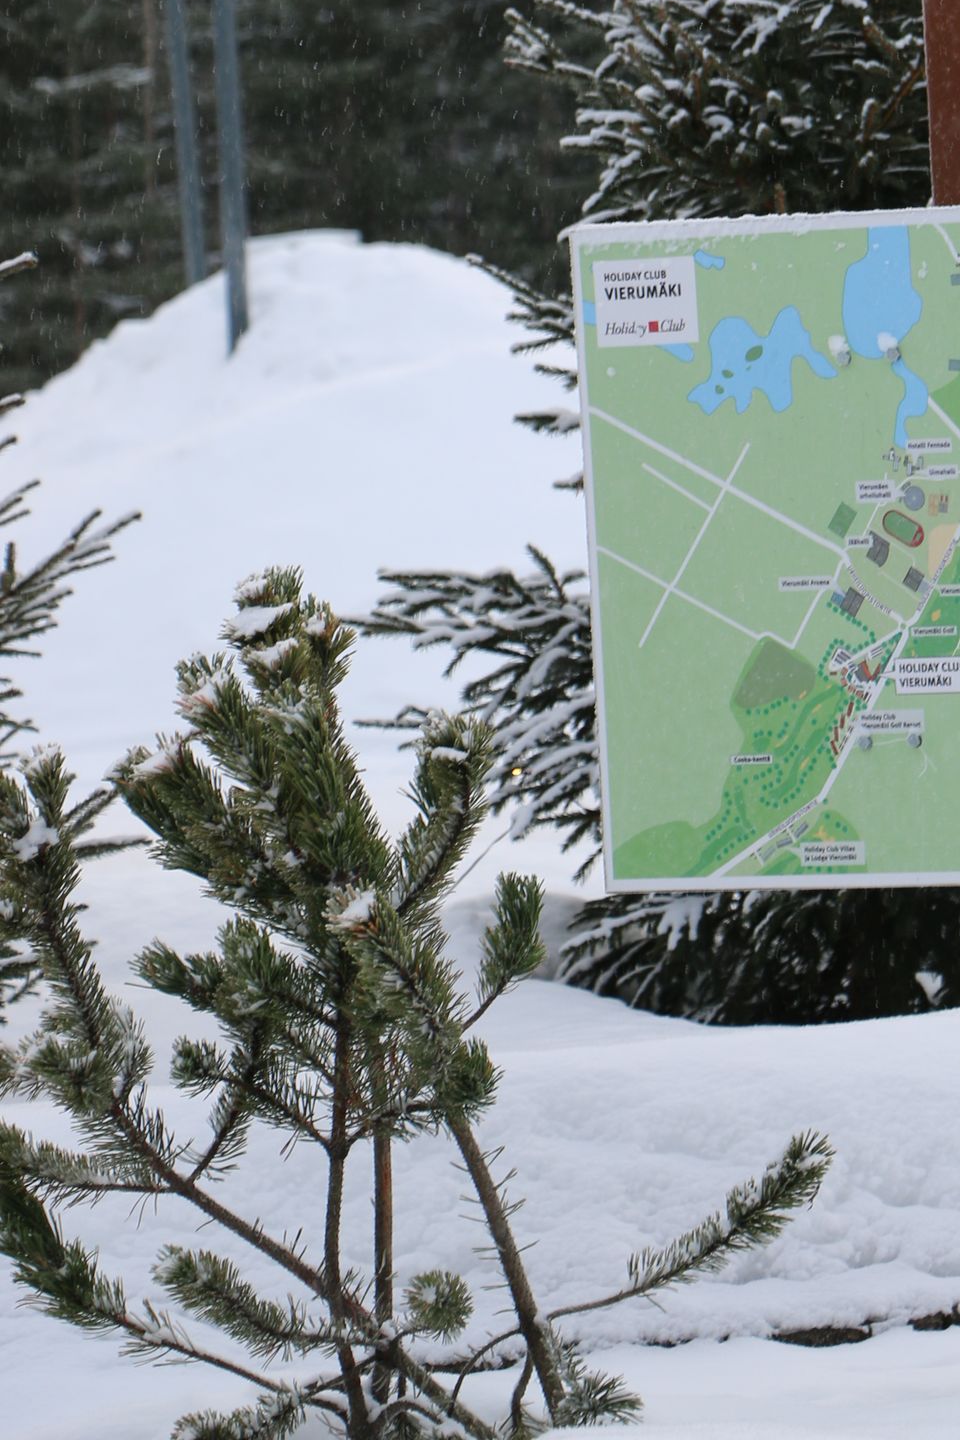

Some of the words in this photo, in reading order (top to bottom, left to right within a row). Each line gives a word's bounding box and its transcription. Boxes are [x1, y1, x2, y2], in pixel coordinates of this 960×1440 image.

[604, 272, 642, 282] HOLIDAY
[644, 270, 667, 280] CLUB
[604, 281, 682, 301] VIERUMÄKI
[660, 318, 686, 333] Club
[898, 663, 939, 674] HOLIDAY
[899, 674, 952, 688] VIERUMÄKI
